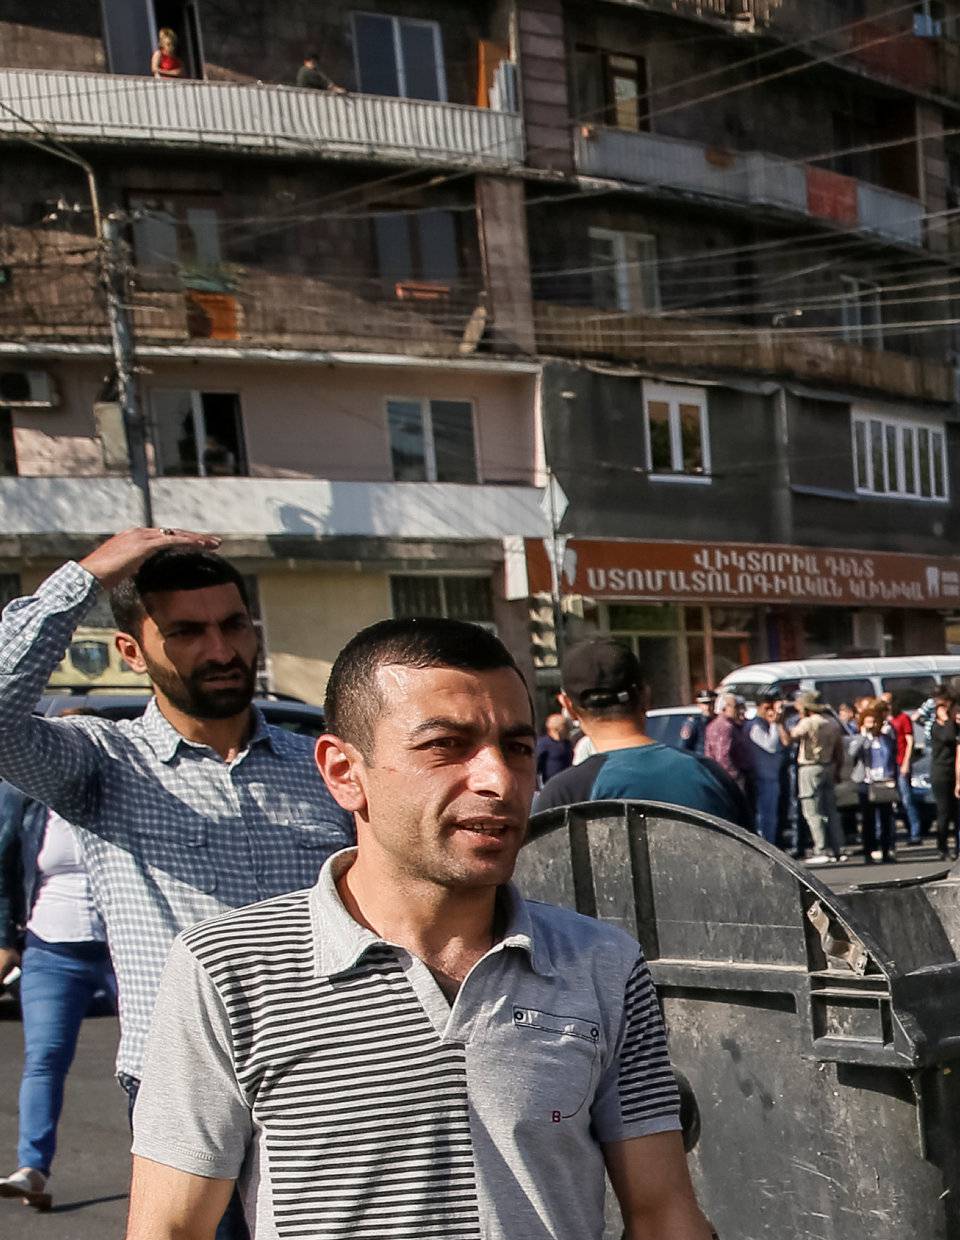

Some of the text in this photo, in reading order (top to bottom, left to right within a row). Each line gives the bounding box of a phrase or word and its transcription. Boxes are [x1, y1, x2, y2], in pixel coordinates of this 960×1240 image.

[693, 549, 874, 578] ՎԻԿՏՈՐԻԱ ԴԵՆՏ
[587, 568, 842, 597] ՍՏՈՄԱՏՈԼՈԳԻԱԿԱՆ
